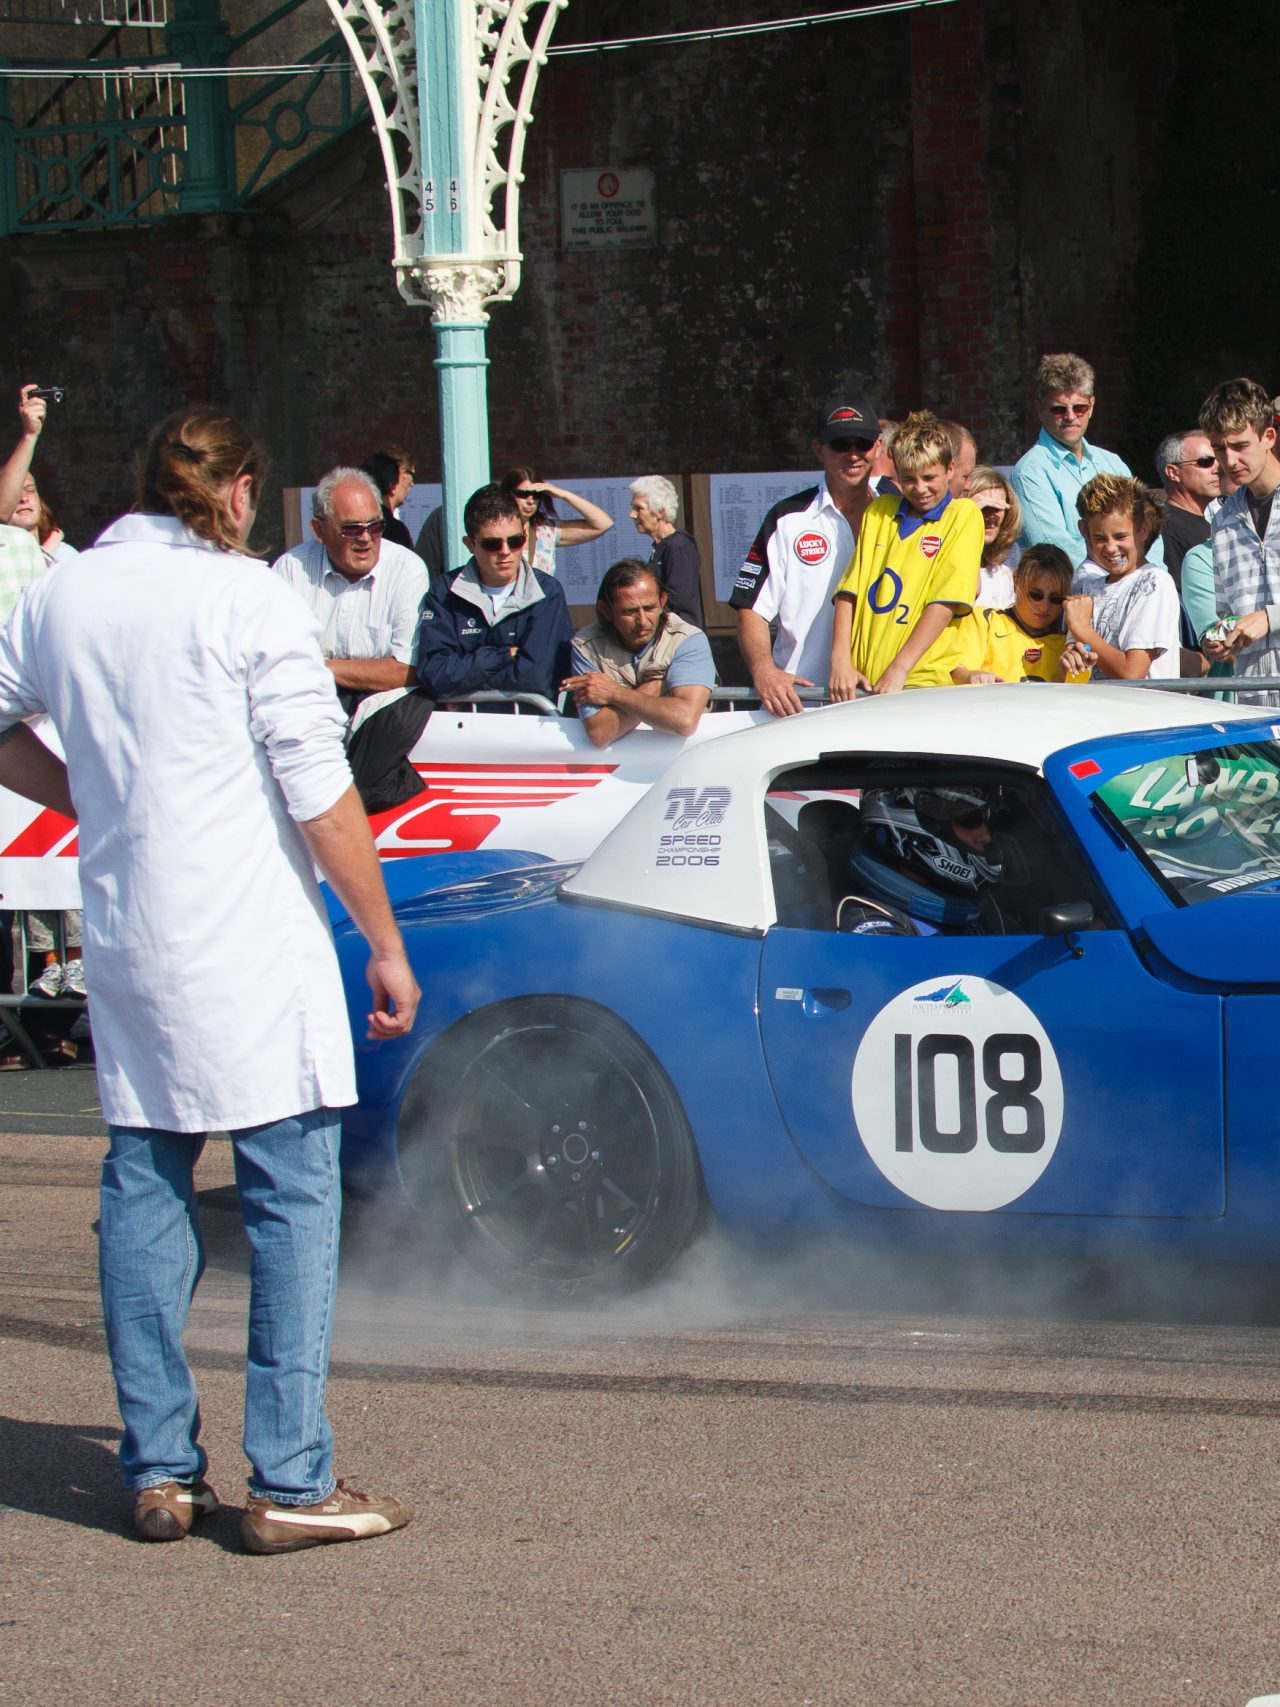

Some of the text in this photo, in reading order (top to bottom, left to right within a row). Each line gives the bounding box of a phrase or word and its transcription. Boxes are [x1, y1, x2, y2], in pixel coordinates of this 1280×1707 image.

[601, 201, 633, 210] OFFENCE
[589, 226, 613, 234] PUBLIC
[799, 539, 823, 549] LUCKY
[800, 548, 825, 557] STRIKE
[1129, 766, 1280, 812] LAND
[664, 787, 731, 821] TVR
[672, 809, 727, 831] Car Club
[660, 834, 721, 846] SPEED
[656, 855, 720, 867] 2006
[938, 859, 971, 879] SHOEI
[894, 1033, 1046, 1154] 108
